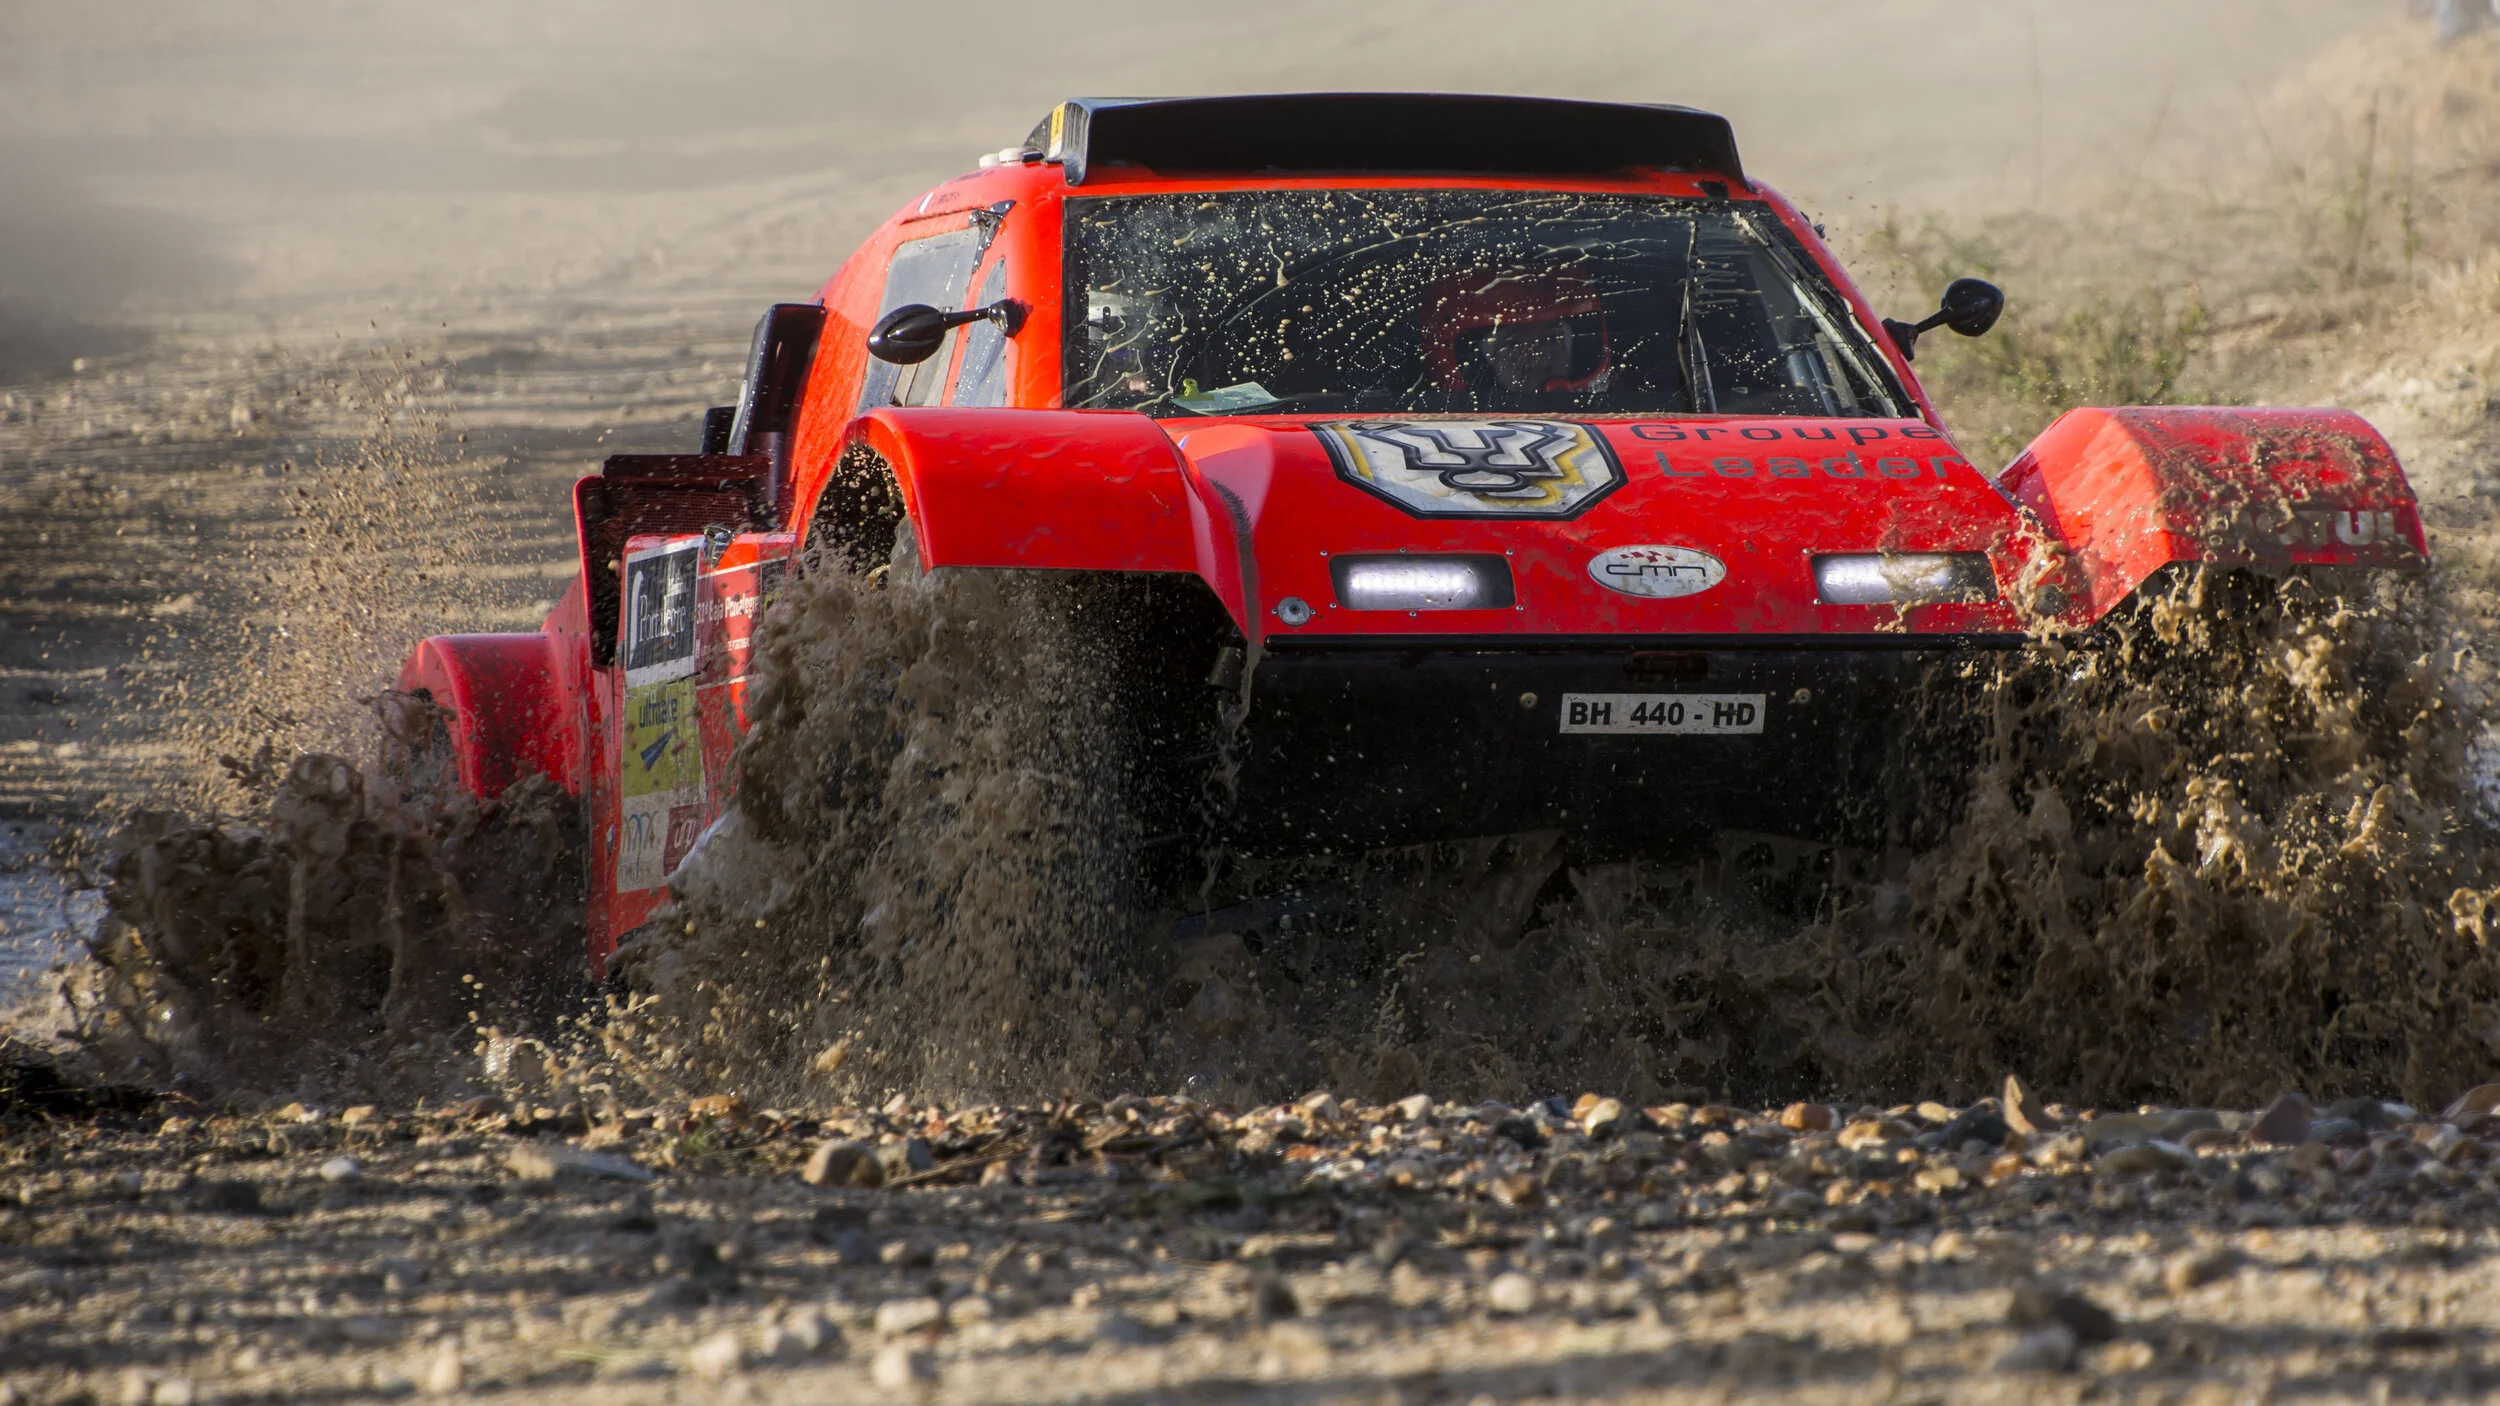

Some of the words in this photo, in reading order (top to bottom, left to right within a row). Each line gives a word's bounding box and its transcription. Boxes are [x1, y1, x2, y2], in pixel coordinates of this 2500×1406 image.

[1630, 424, 1942, 446] Groupe
[1652, 450, 1965, 479] Leader
[639, 690, 678, 728] ultimate
[1568, 702, 1612, 726] BH
[1630, 702, 1685, 726] 440
[1713, 702, 1756, 726] HD
